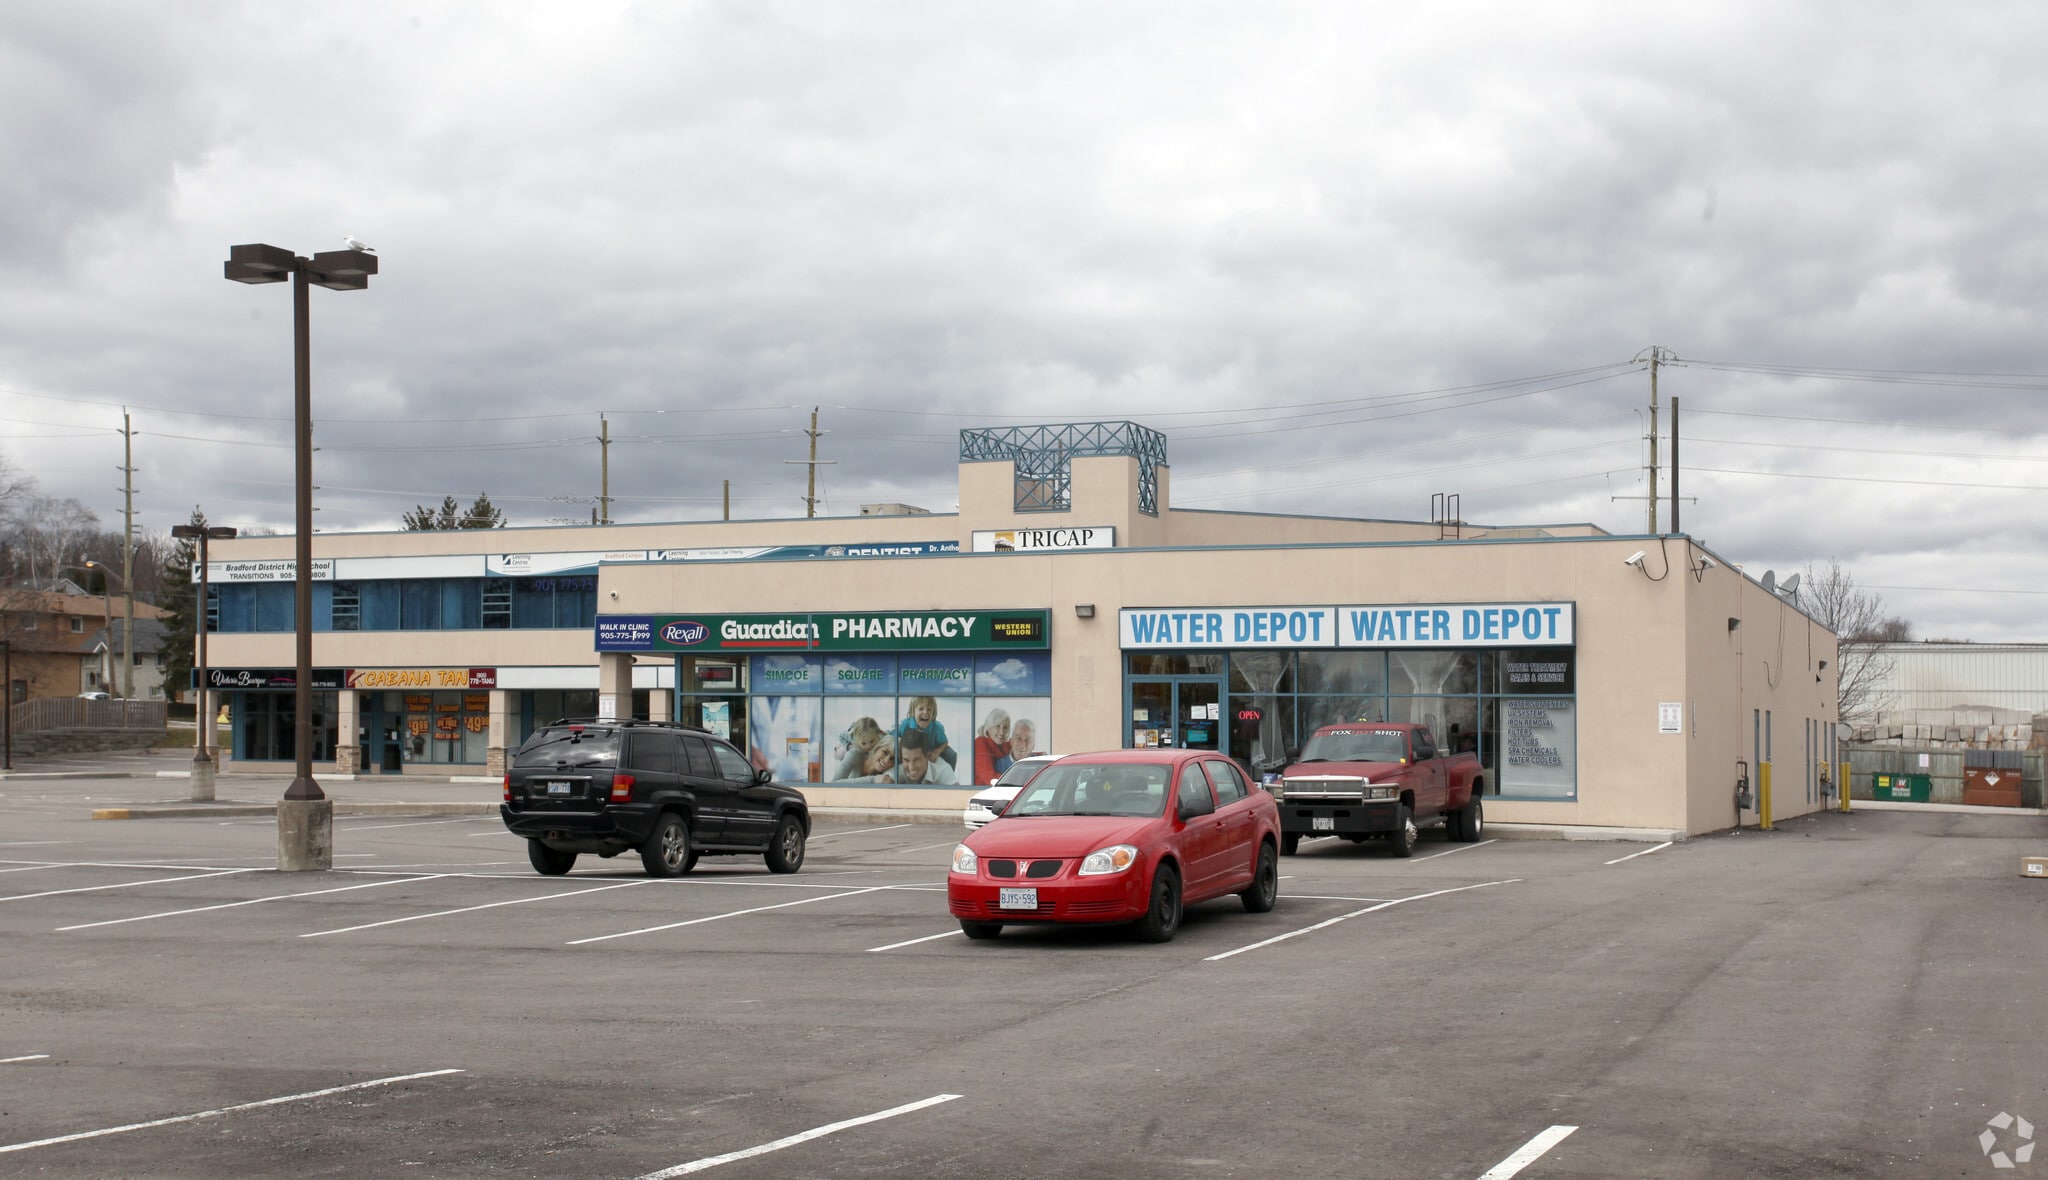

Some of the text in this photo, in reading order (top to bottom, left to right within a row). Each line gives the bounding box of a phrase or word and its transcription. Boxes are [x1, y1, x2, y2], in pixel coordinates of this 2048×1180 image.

[1018, 529, 1093, 547] TRICAP
[226, 564, 256, 572] Bradford
[258, 563, 285, 571] District
[311, 562, 330, 570] chool
[720, 620, 819, 639] Guardian
[832, 616, 977, 638] PHARMACY
[1131, 611, 1325, 643] WATER DEPOT
[1350, 607, 1561, 641] WATER DEPOT
[666, 626, 704, 643] Rexall
[364, 670, 469, 687] CABANA TAN
[765, 668, 969, 681] SIMCOE SQUARE PHARMACY
[1237, 710, 1260, 721] OPEN
[1517, 709, 1547, 717] SYSTEMS
[1507, 719, 1554, 727] IRON REMOVAL
[1507, 728, 1533, 736] FILTERS
[1522, 737, 1539, 745] TUBS
[1507, 747, 1558, 755] SPA CHEMICALS
[1507, 756, 1562, 764] WATER COOLERS
